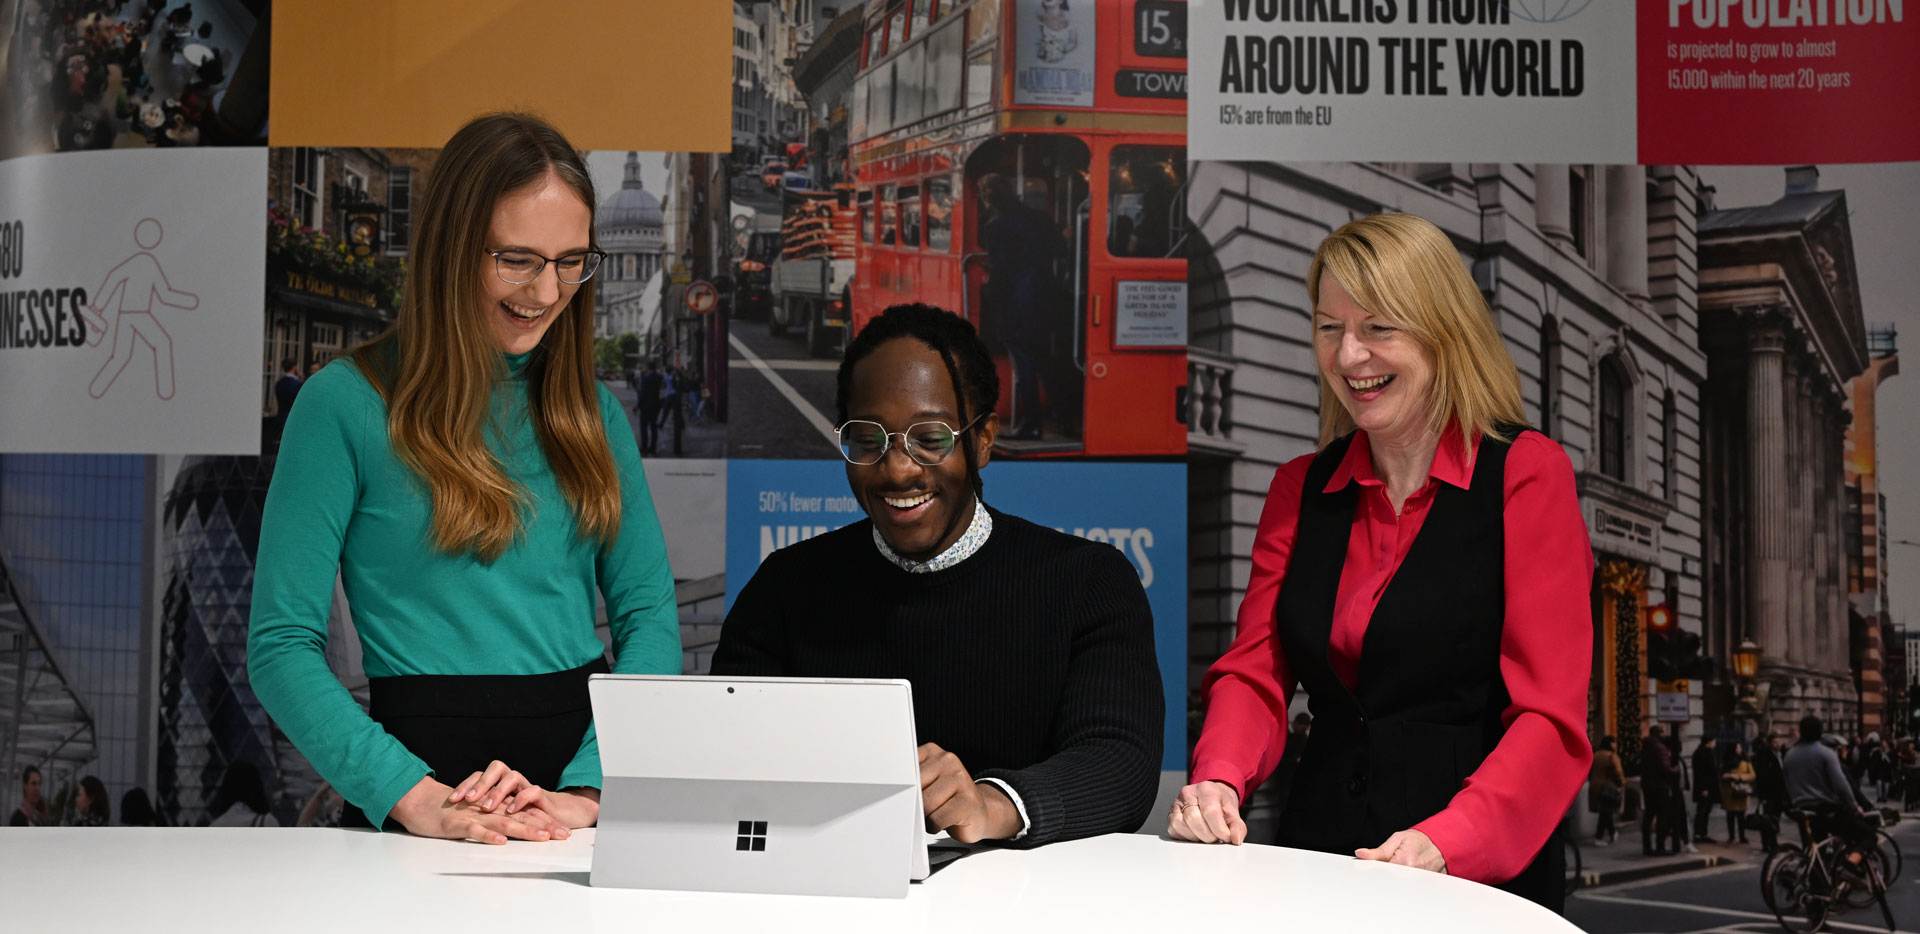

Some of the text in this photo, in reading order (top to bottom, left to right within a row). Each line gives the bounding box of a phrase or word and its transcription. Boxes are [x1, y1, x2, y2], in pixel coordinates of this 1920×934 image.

[1141, 10, 1171, 45] 15
[1667, 37, 1836, 63] is projected to grow to almost
[1219, 35, 1584, 97] AROUND THE WORLD
[1710, 69, 1746, 89] within
[1748, 69, 1767, 89] the
[1770, 71, 1795, 89] next
[1797, 67, 1814, 89] 20
[1816, 71, 1851, 92] years
[1219, 104, 1332, 126] 15% are from the EU
[759, 490, 787, 512] 50%
[789, 491, 822, 512] fewer
